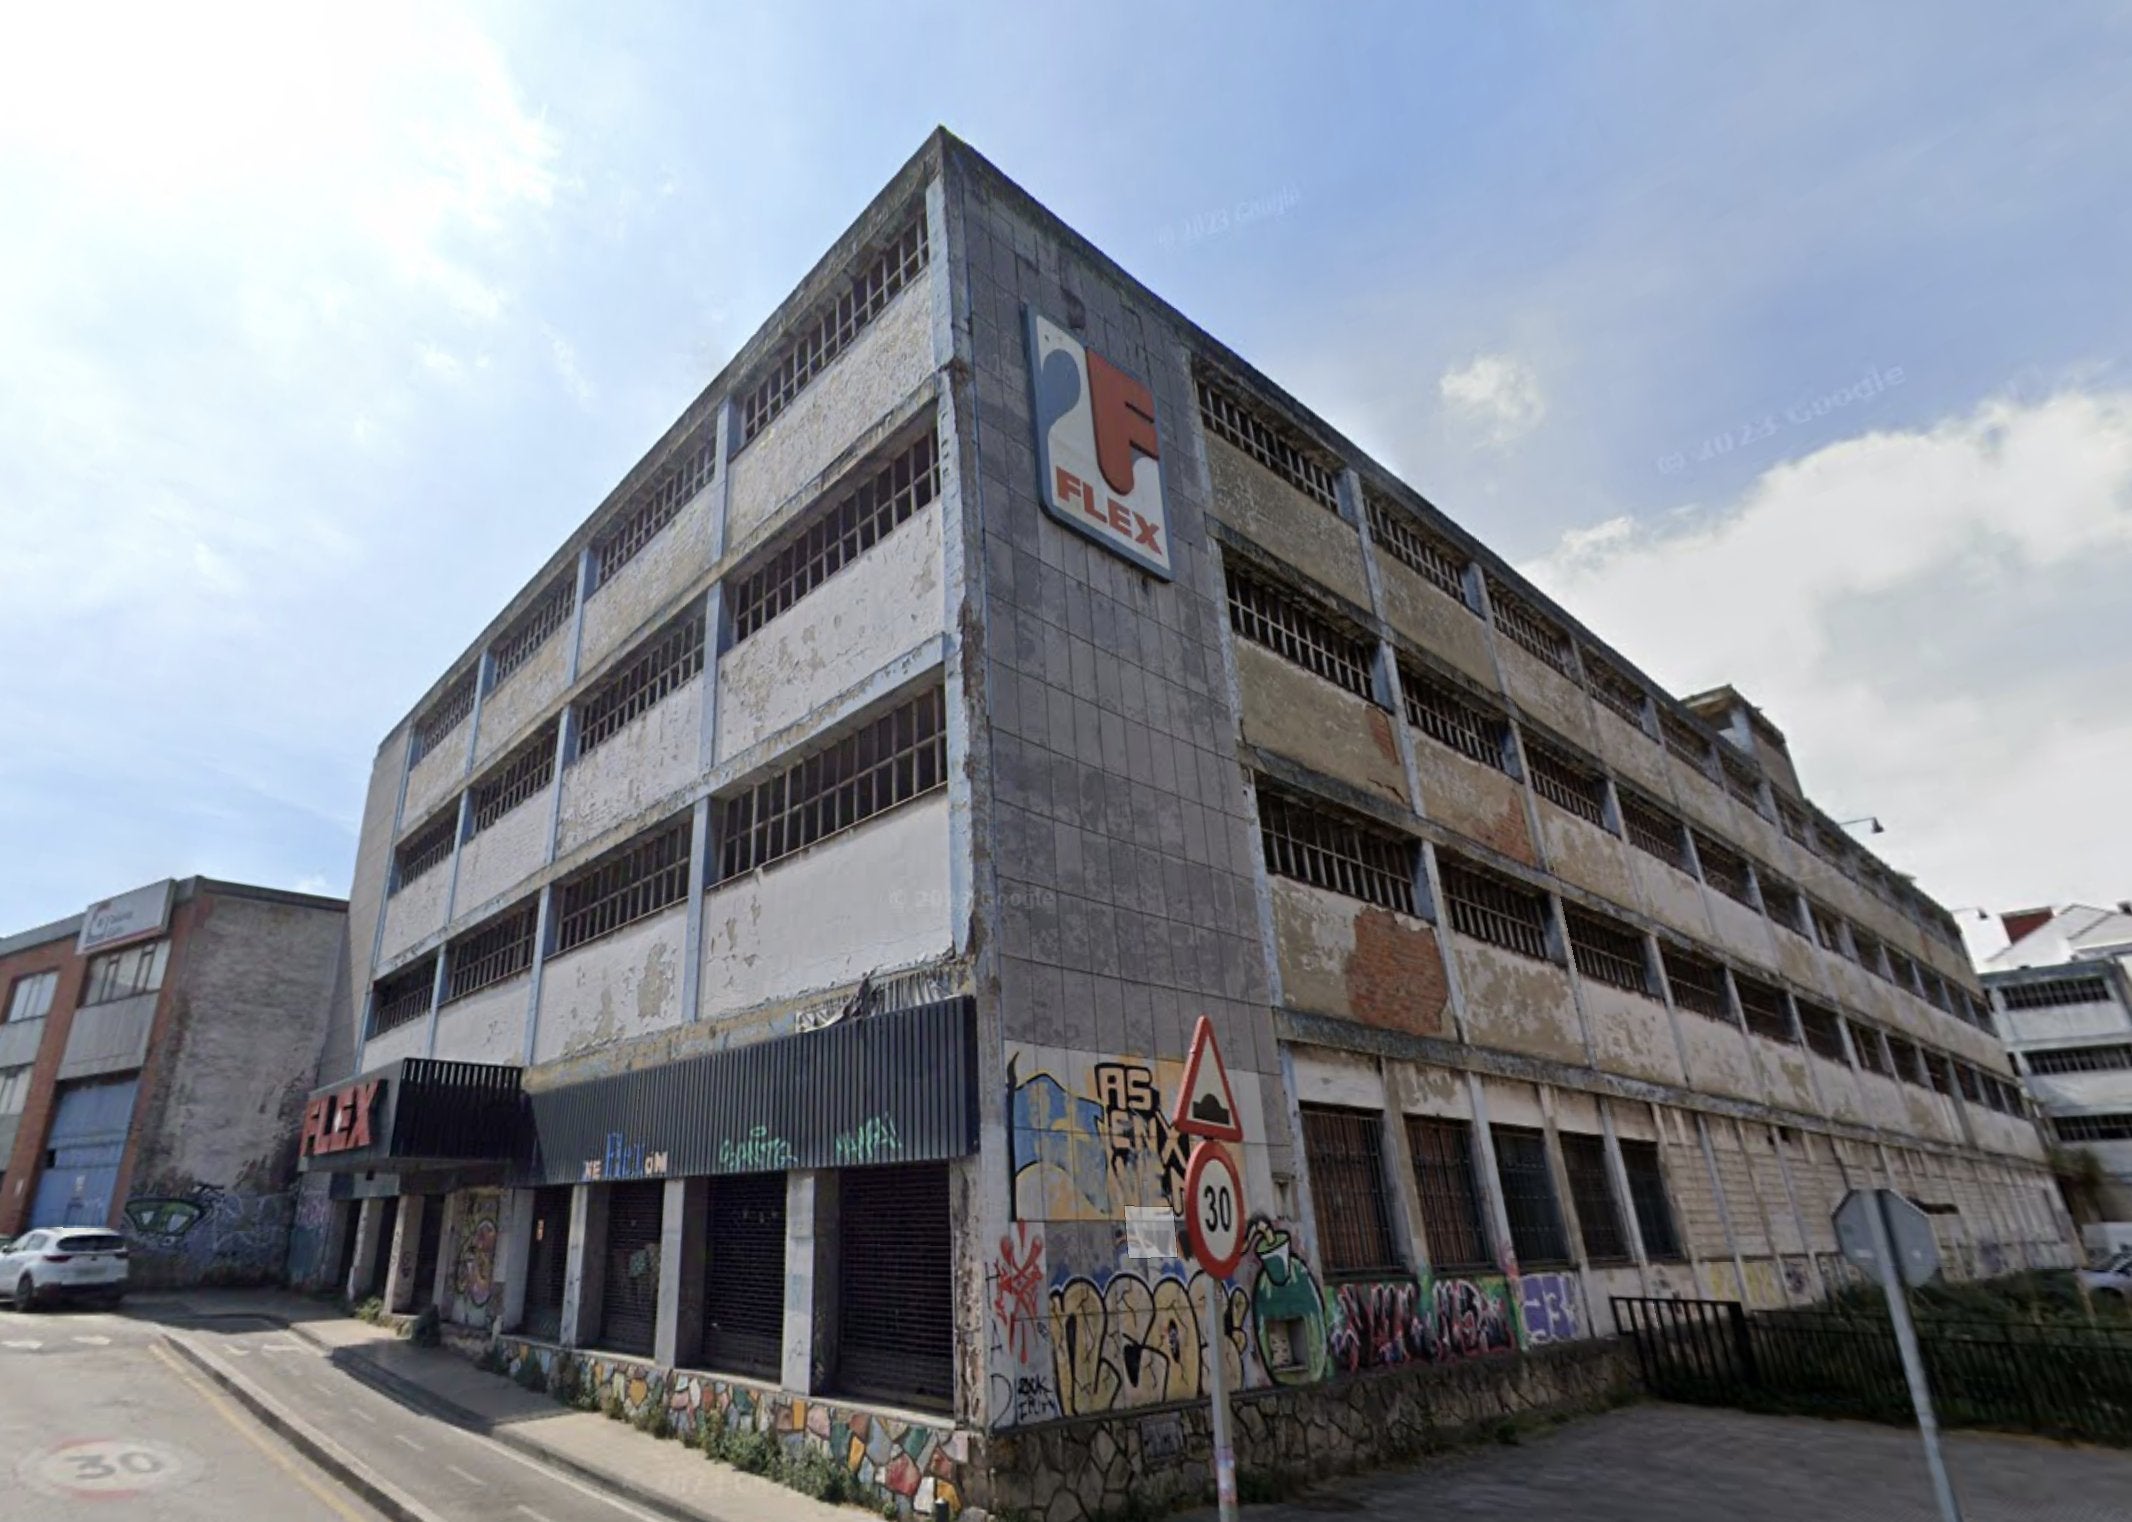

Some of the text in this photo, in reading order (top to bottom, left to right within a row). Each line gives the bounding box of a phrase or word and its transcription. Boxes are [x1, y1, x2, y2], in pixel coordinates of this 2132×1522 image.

[1056, 466, 1163, 556] FLEX
[299, 1080, 380, 1156] FLEX
[1203, 1185, 1232, 1233] 30
[64, 1452, 164, 1480] 30
